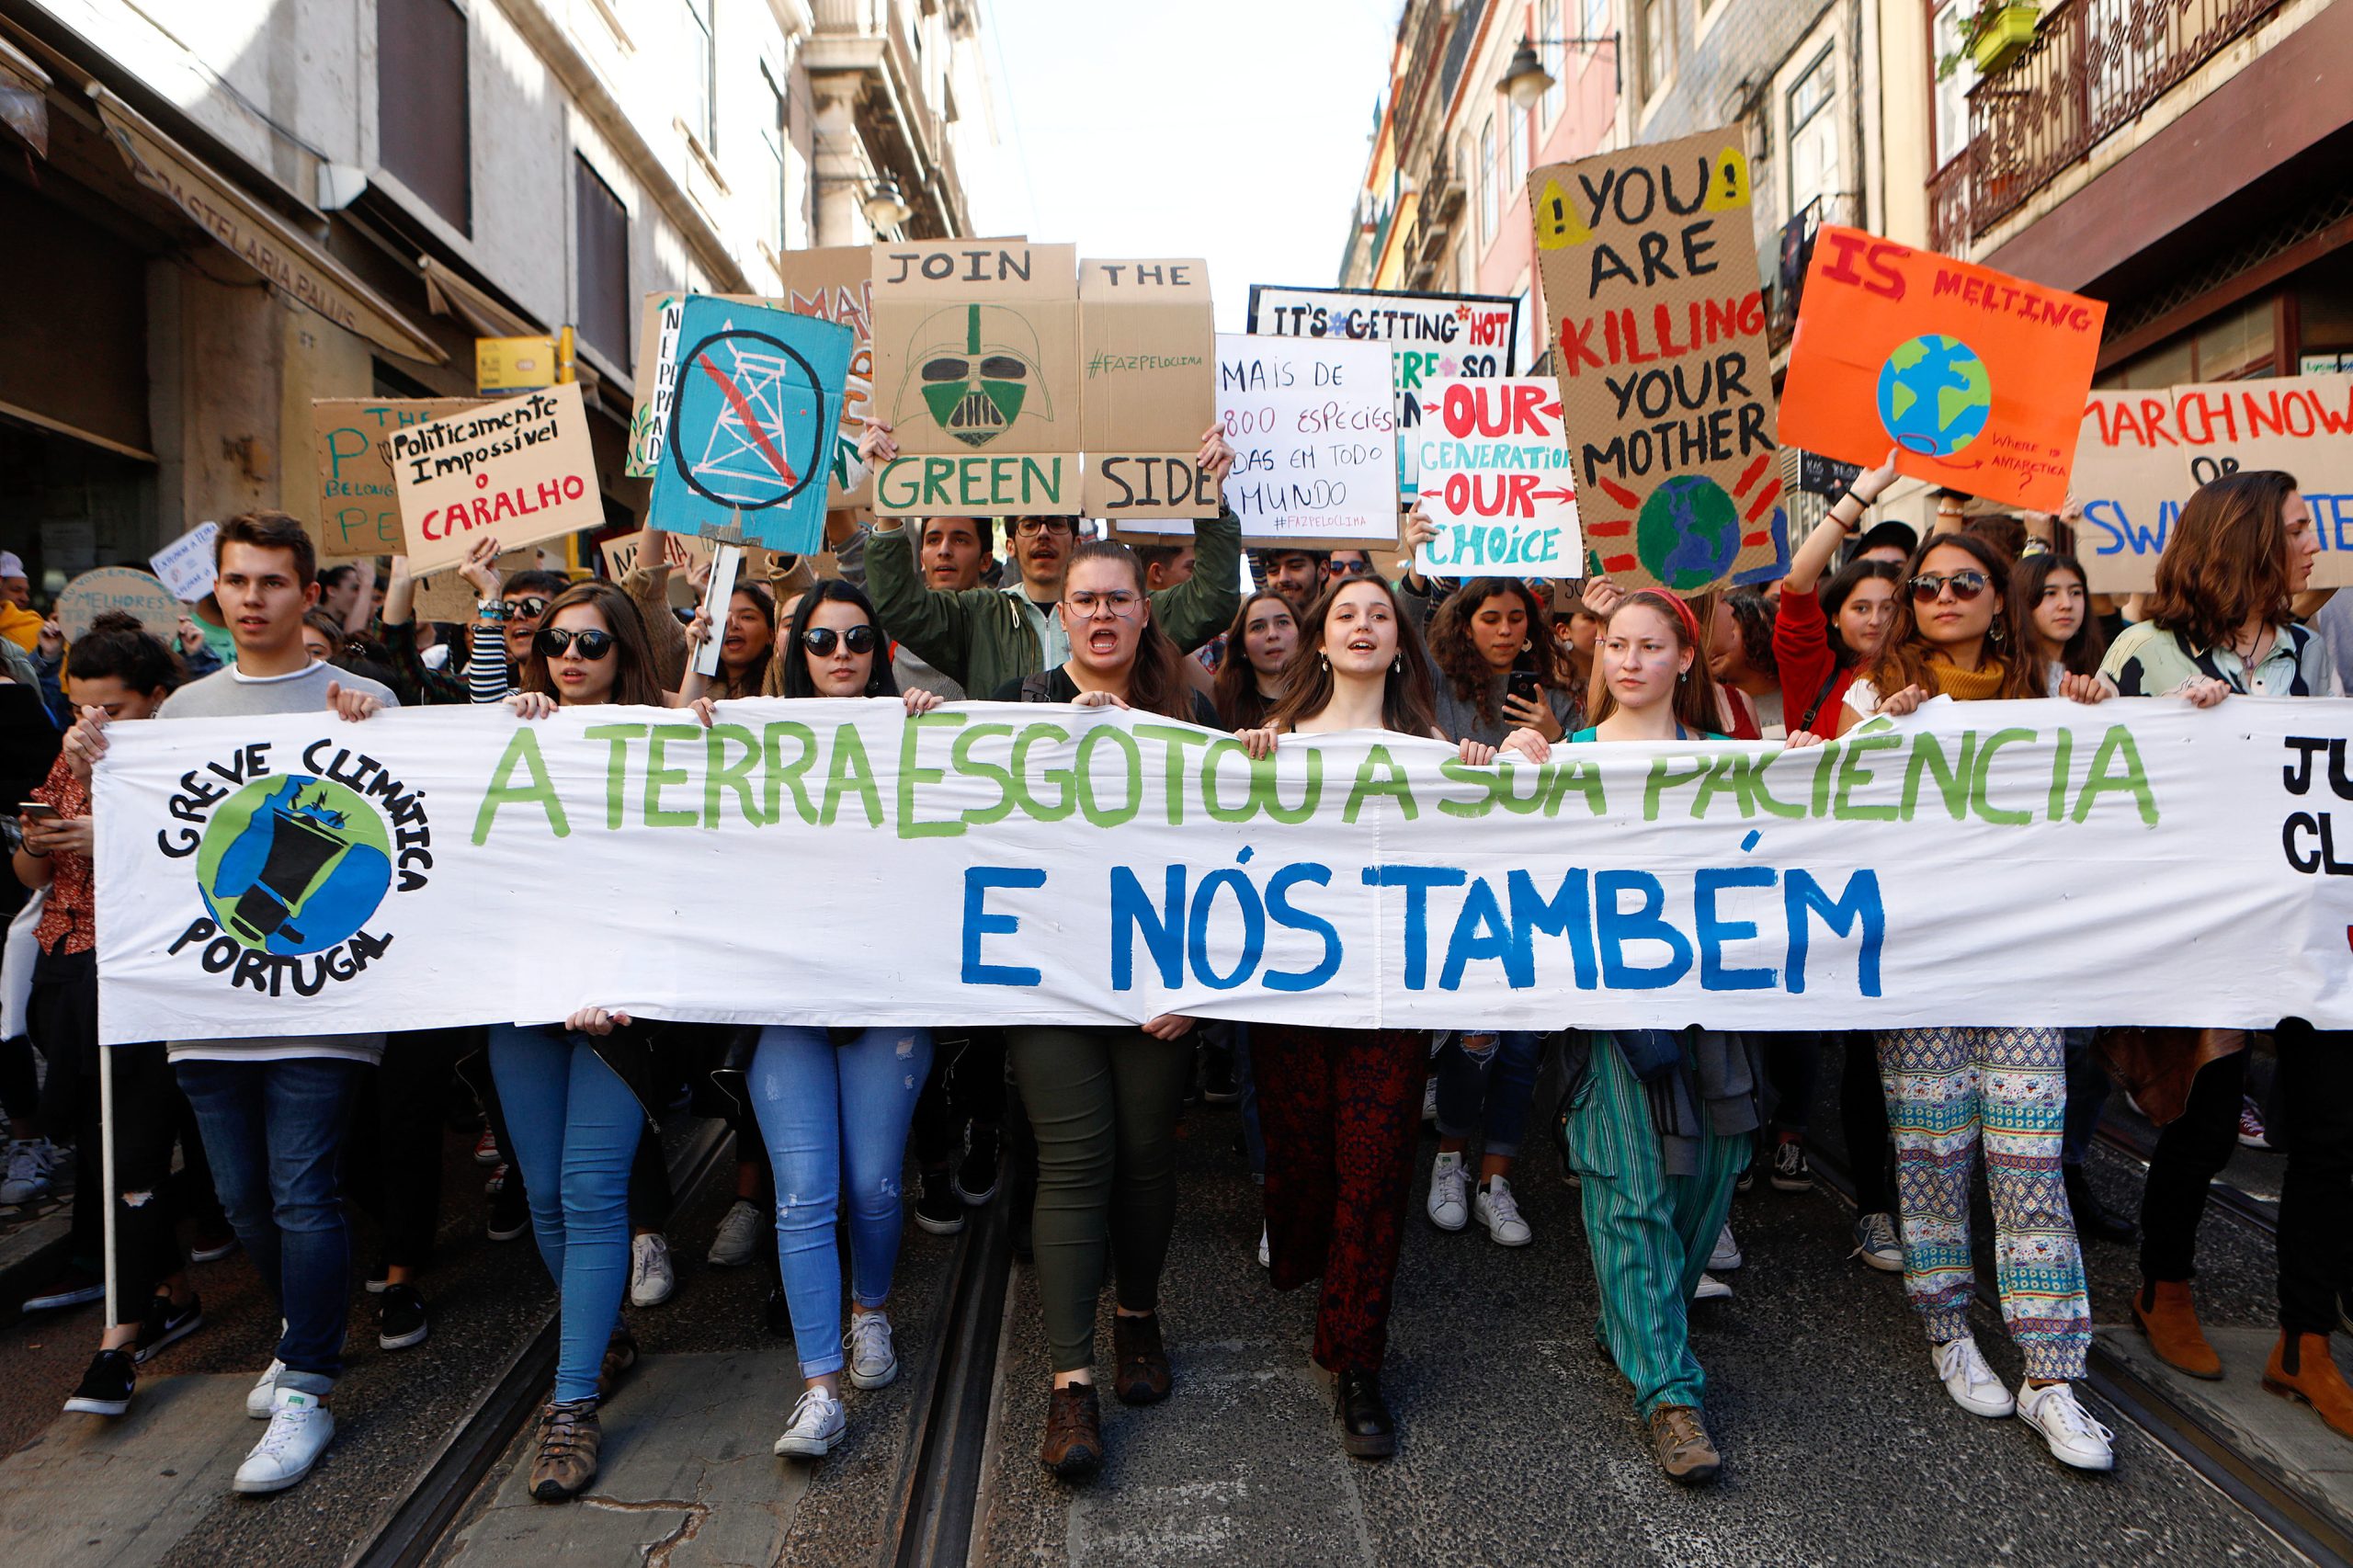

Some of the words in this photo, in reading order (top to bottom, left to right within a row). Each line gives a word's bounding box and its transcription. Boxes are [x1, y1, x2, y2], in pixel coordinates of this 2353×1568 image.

[1577, 156, 1710, 230] YOU
[887, 249, 1030, 283] JOIN
[1100, 265, 1191, 287] THE
[1588, 219, 1720, 301] ARE
[1821, 233, 1912, 303] IS
[1933, 269, 2093, 334] MELTING
[1273, 302, 1329, 338] IT'S
[1345, 307, 1460, 344] GETTING
[1470, 312, 1510, 347] HOT
[1559, 290, 1767, 377] KILLING
[1087, 347, 1203, 380] #FAZPELOCLIMA
[1314, 360, 1343, 387] DE
[1605, 351, 1754, 421] YOUR
[1223, 407, 1276, 437] 800
[1442, 383, 1551, 438] OUR
[2242, 386, 2353, 438] NOW
[410, 420, 559, 485] Impossível
[1290, 445, 1315, 470] EM
[1582, 401, 1777, 488] MOTHER
[1991, 455, 2066, 477] ANTARCTICA
[422, 475, 585, 541] CARALHO
[878, 456, 1062, 509] GREEN
[1102, 456, 1216, 509] SIDE
[1241, 480, 1347, 516] MUNDO
[1444, 472, 1541, 518] OUR
[1274, 515, 1367, 530] #FAZPELOCLIMA
[157, 742, 272, 858] GREVE
[471, 726, 571, 846] A
[584, 721, 884, 831] TERRA
[897, 711, 1324, 840] ESGOTOU
[1341, 744, 1419, 824] A
[1437, 756, 1608, 818] SUA
[1643, 715, 2160, 830] PACIÊNCIA
[961, 866, 1048, 987] E
[1110, 845, 1344, 992] NÓS
[1362, 830, 1886, 998] TAMBÉM
[166, 917, 394, 997] PORTUGAL
